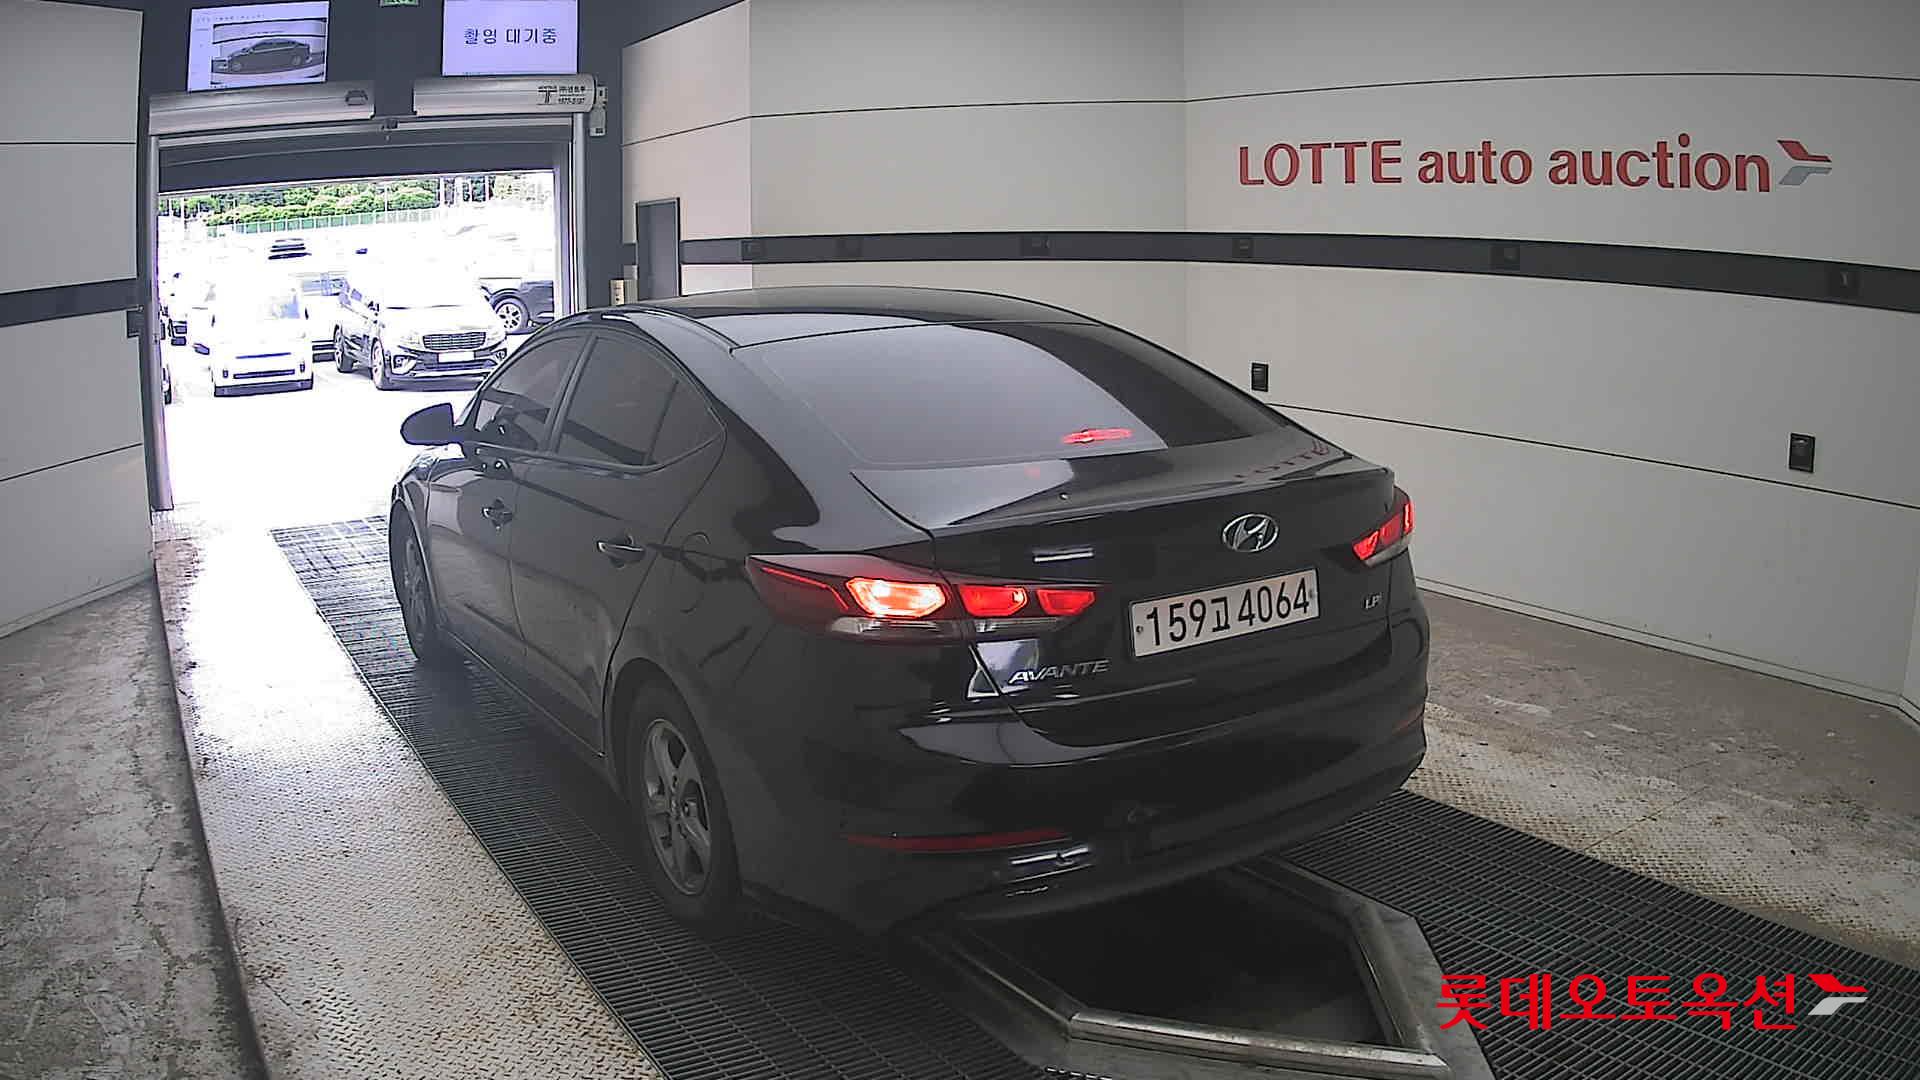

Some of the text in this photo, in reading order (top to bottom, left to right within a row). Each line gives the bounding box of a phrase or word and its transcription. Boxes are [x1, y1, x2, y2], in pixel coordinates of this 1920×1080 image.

[506, 27, 557, 45] 대기중
[1239, 133, 1770, 192] LOTTE auto auction
[1008, 659, 1110, 684] AVANTE
